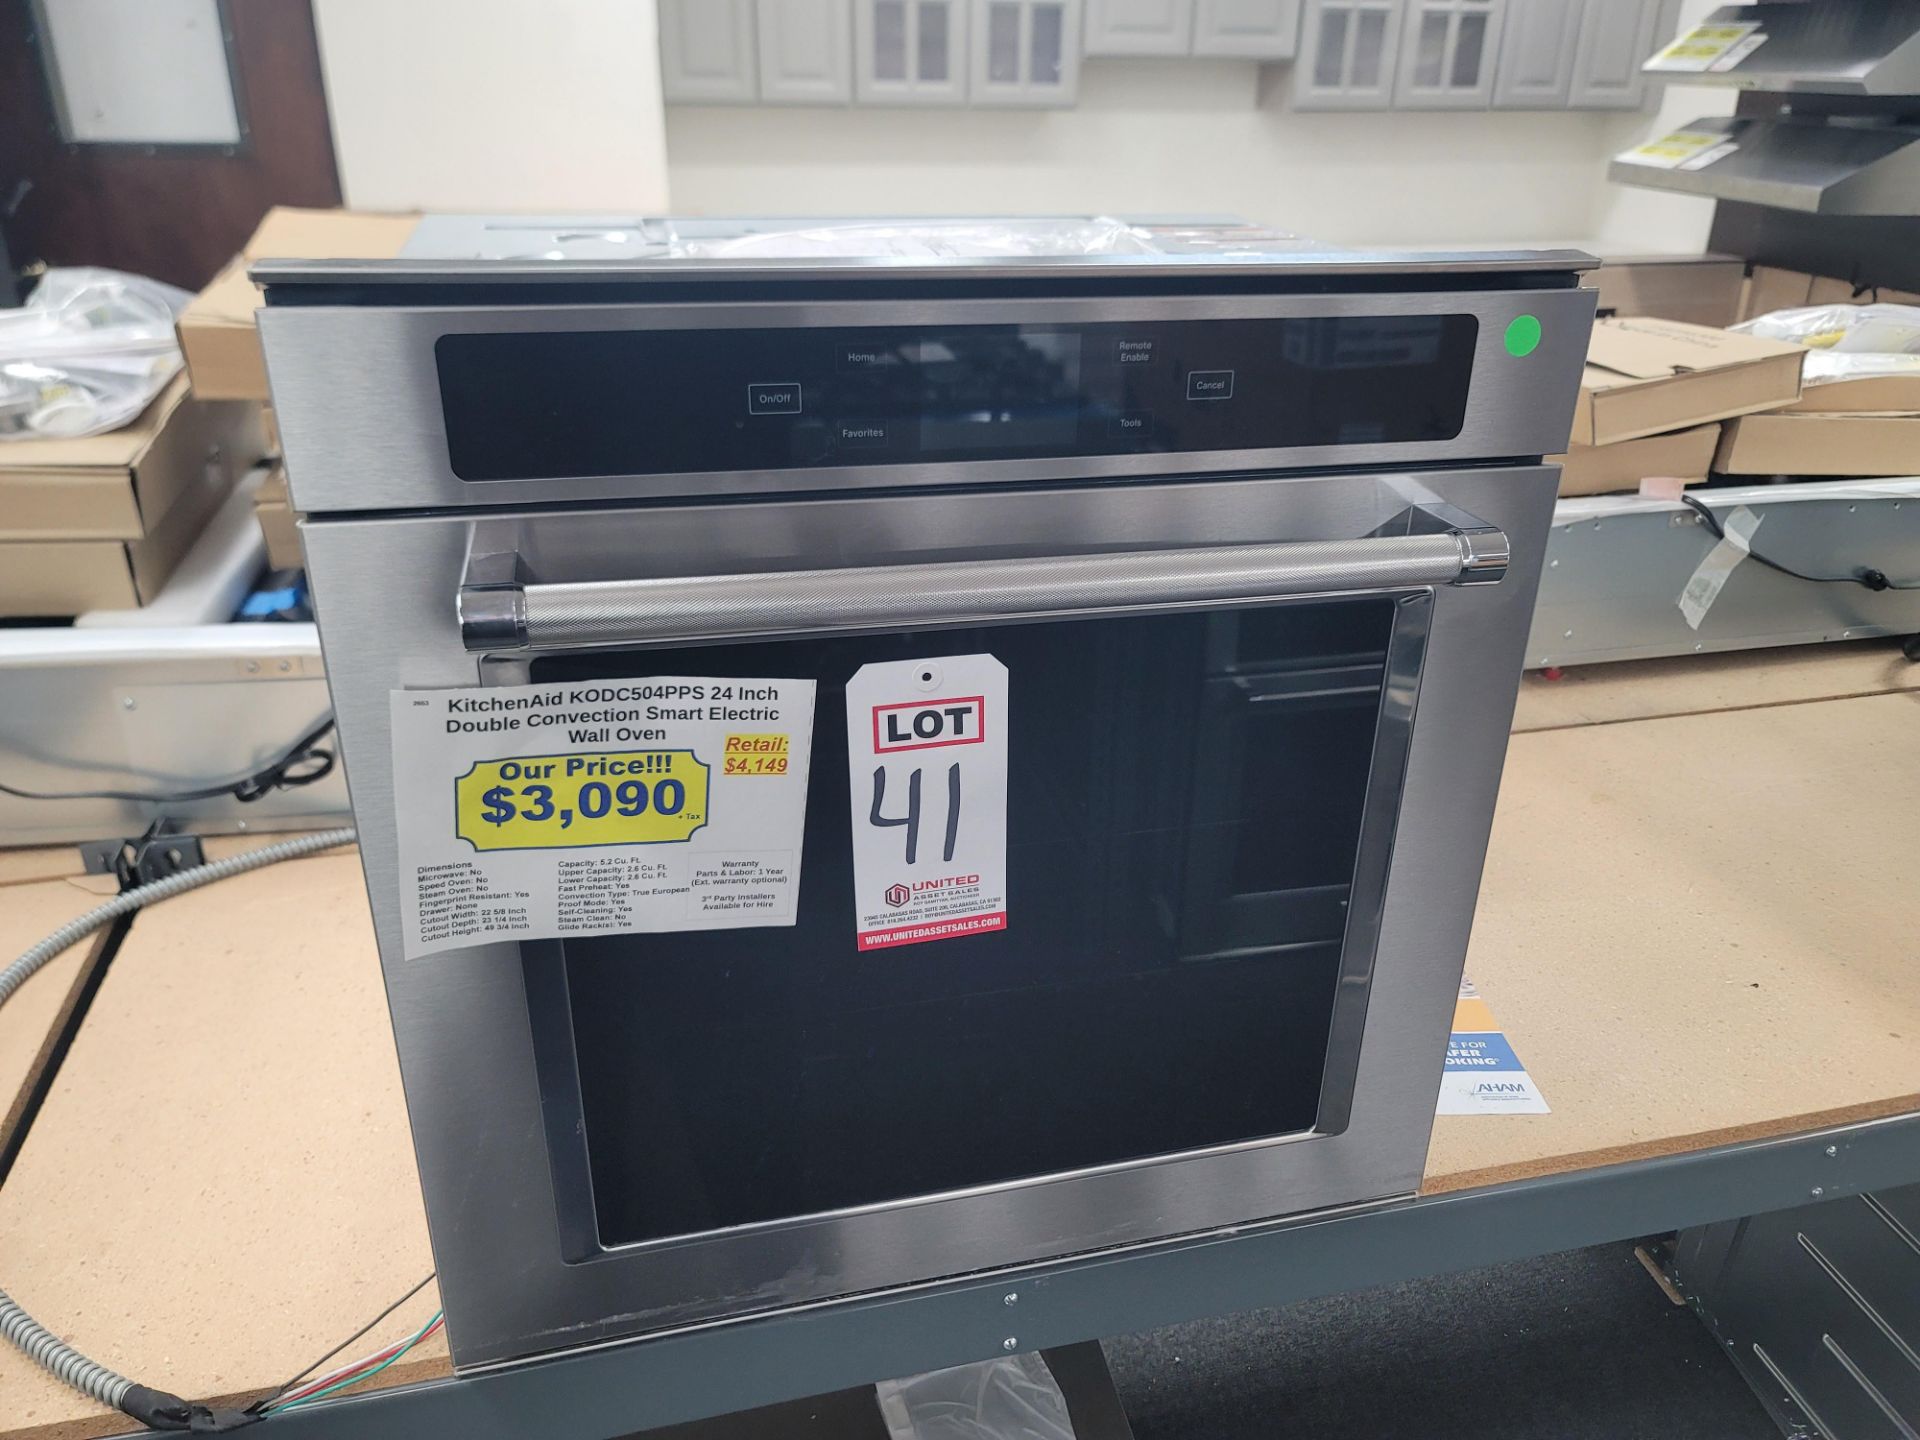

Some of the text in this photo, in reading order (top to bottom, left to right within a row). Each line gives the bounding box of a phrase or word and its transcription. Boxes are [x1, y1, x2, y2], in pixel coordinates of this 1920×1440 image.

[1119, 341, 1152, 350] Remote
[848, 353, 876, 362] Home
[1120, 353, 1149, 362] Enable
[1196, 381, 1225, 390] Cancel
[759, 393, 791, 404] On/Off
[1120, 418, 1142, 428] Tools
[842, 429, 884, 438] Favorites
[448, 685, 779, 713] KitchenAid KODC504PPS 24 Inch
[446, 705, 780, 734] Double Convection Smart Electric
[887, 706, 972, 743] LOT
[568, 727, 666, 744] Wall Oven
[725, 736, 789, 752] Retail:
[499, 754, 672, 781] Our Price!!!
[724, 757, 788, 774] $4,149
[481, 778, 685, 829] $3,090
[686, 812, 701, 821] Tax
[869, 762, 961, 865] 41
[417, 861, 473, 874] Dimensions
[558, 860, 598, 869] Capacity:
[721, 860, 760, 868] Warranty
[418, 871, 468, 883] Microwave:
[558, 869, 583, 878] Upper
[586, 866, 625, 876] Capacity:
[418, 881, 446, 892] Speed
[448, 878, 473, 886] Oven:
[586, 875, 625, 884] Capacity:
[691, 876, 788, 887] (Ext. warranty optional)
[912, 874, 980, 892] UNITED
[419, 891, 446, 900] Steam
[448, 886, 474, 895] Oven:
[558, 892, 606, 900] Convection
[608, 891, 630, 899] Type:
[652, 887, 690, 895] European
[713, 894, 736, 902] Party
[737, 893, 776, 901] Installers
[913, 886, 980, 901] ASSET SALES
[419, 895, 467, 909] Fingerprint
[469, 892, 512, 901] Resistant:
[558, 900, 581, 908] Proof
[583, 899, 608, 907] Mode:
[702, 902, 741, 911] Available
[420, 902, 478, 917] Drawer: None
[558, 907, 616, 916] Self-Cleaning:
[420, 915, 449, 925] Cutout
[451, 910, 479, 920] Width:
[586, 914, 613, 922] Clean:
[420, 924, 449, 934] Cutout
[451, 918, 479, 930] Depth:
[558, 923, 580, 931] Glide
[865, 916, 1001, 945] WWW.UNITEDASSETSALES.COM
[421, 932, 450, 943] Cutout
[452, 926, 482, 937] Height:
[1446, 1049, 1482, 1057] AFER
[1444, 1057, 1497, 1065] OKING
[1477, 1083, 1526, 1093] AHAM
